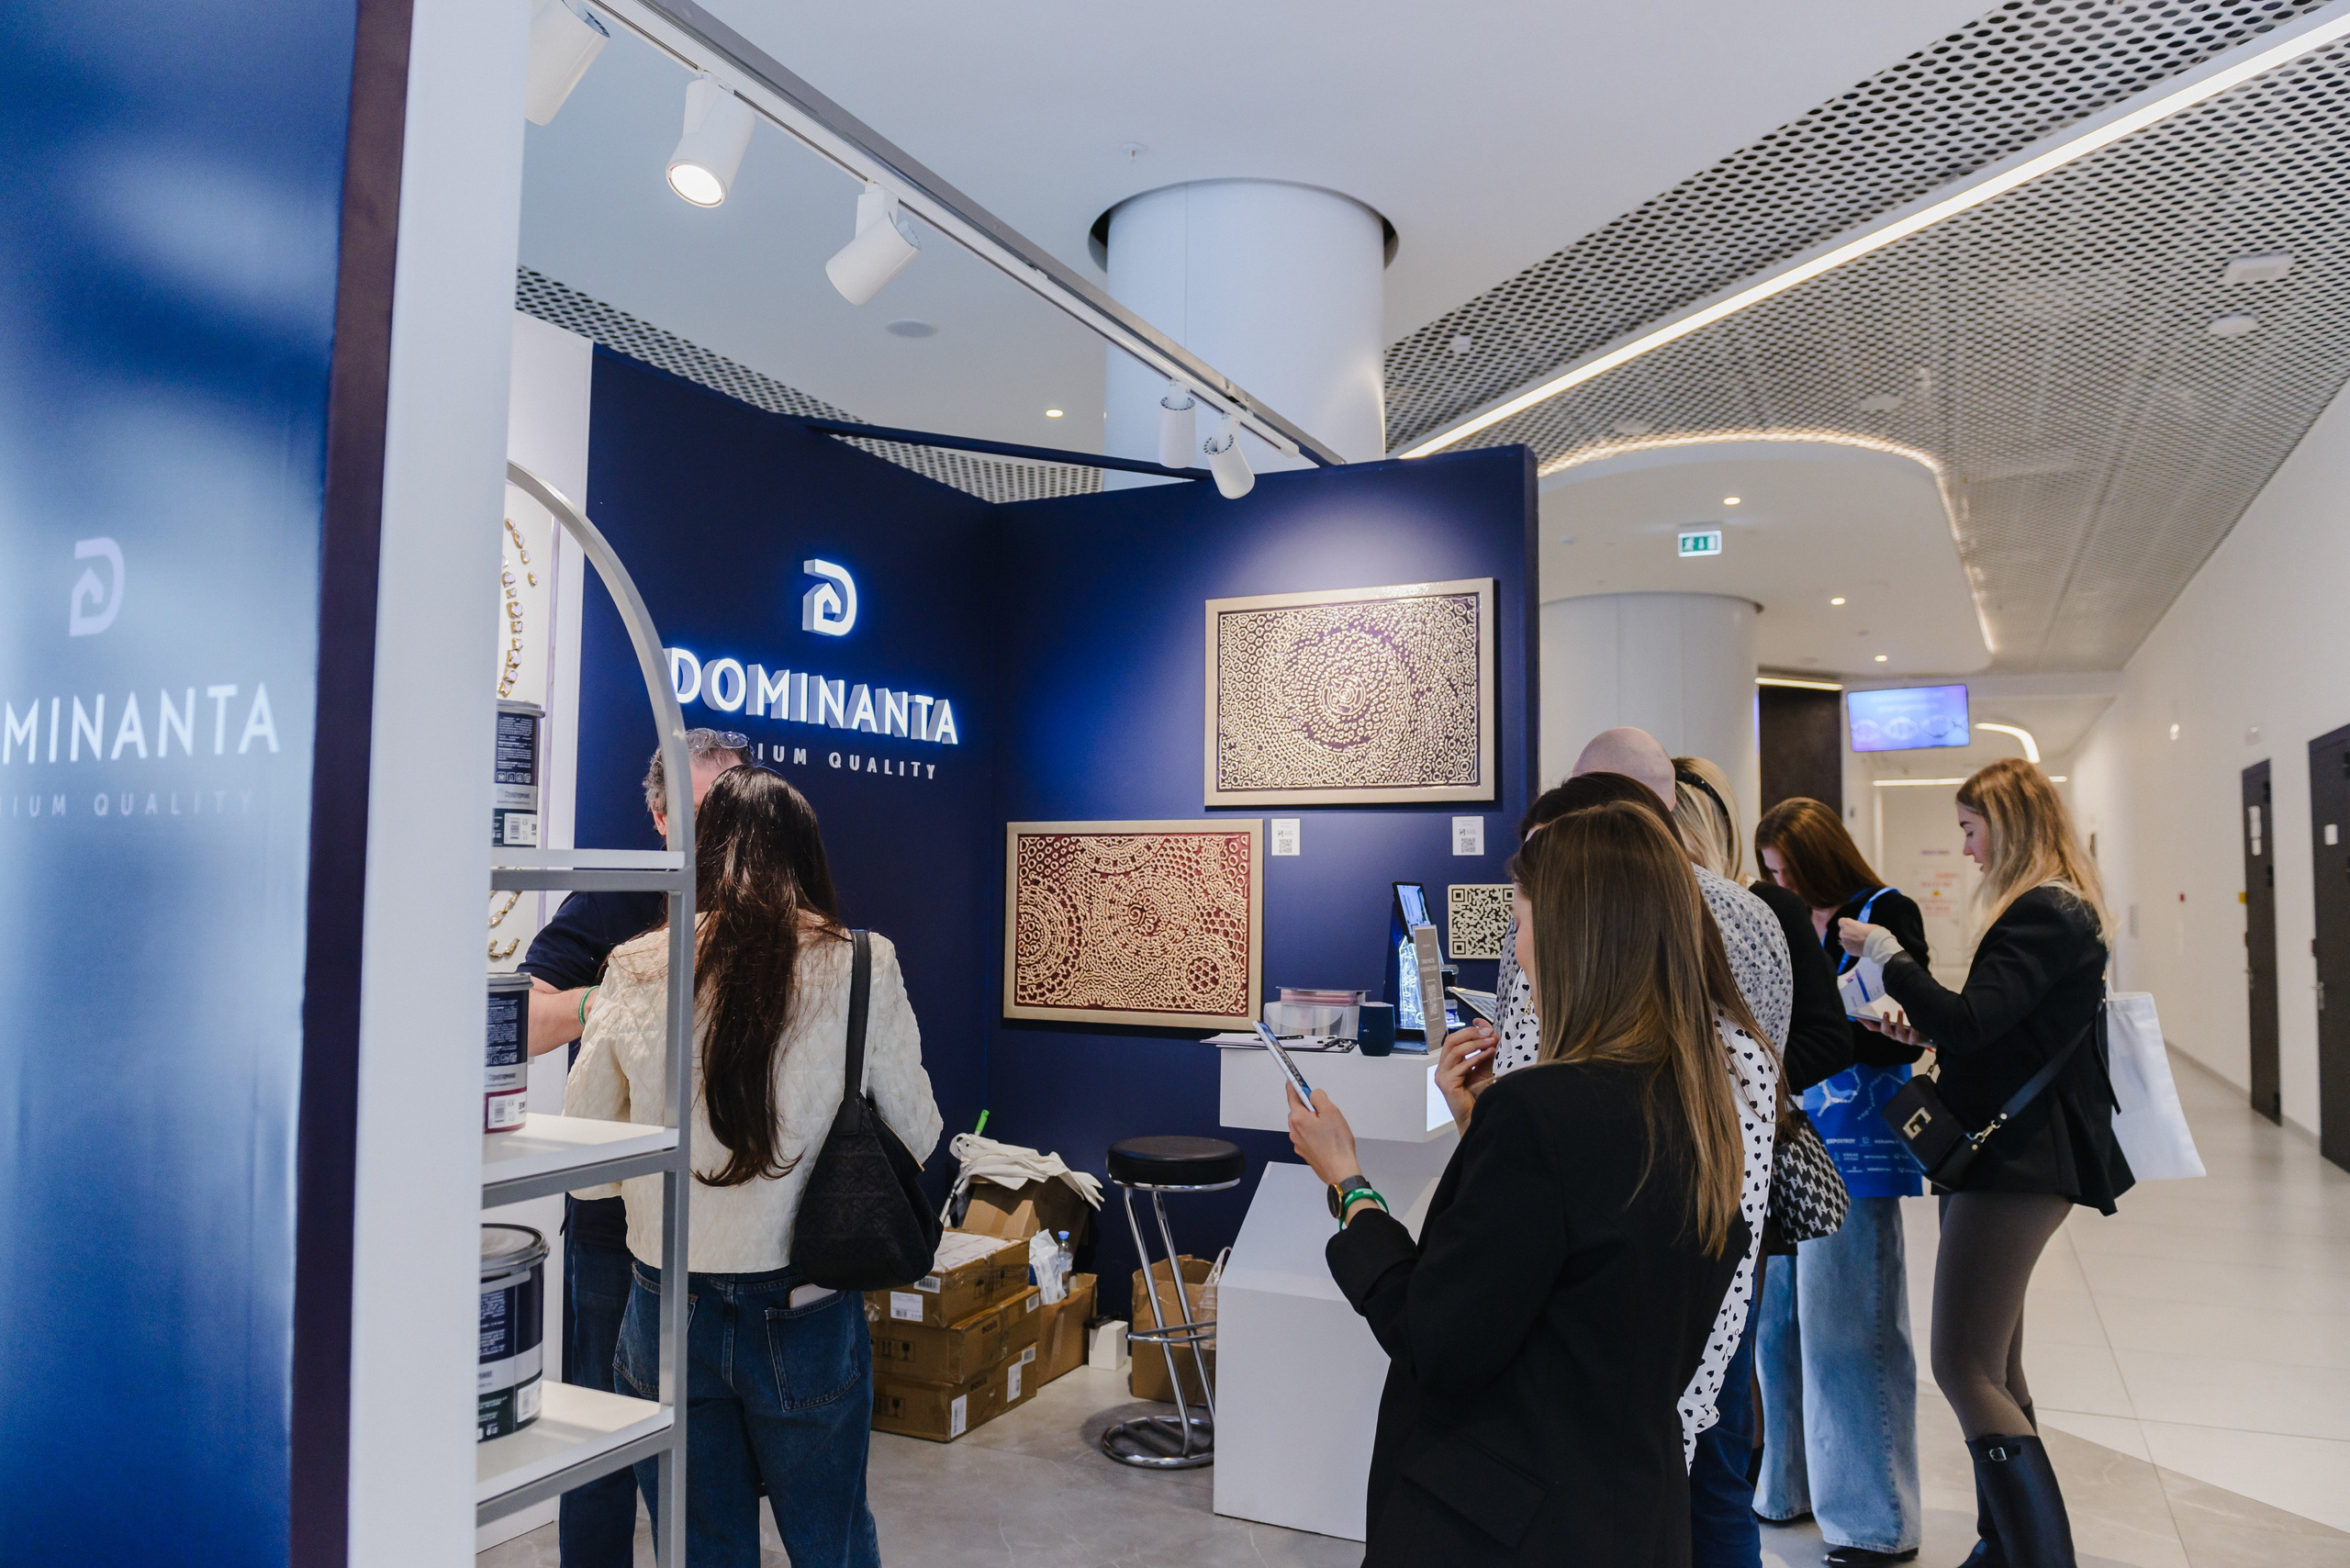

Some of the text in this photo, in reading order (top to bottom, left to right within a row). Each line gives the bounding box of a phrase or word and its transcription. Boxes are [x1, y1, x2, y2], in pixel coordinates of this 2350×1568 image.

[2, 681, 281, 766] MINANTA
[669, 646, 958, 745] DOMINANTA
[828, 751, 936, 780] QUALITY
[93, 790, 252, 817] QUALITY
